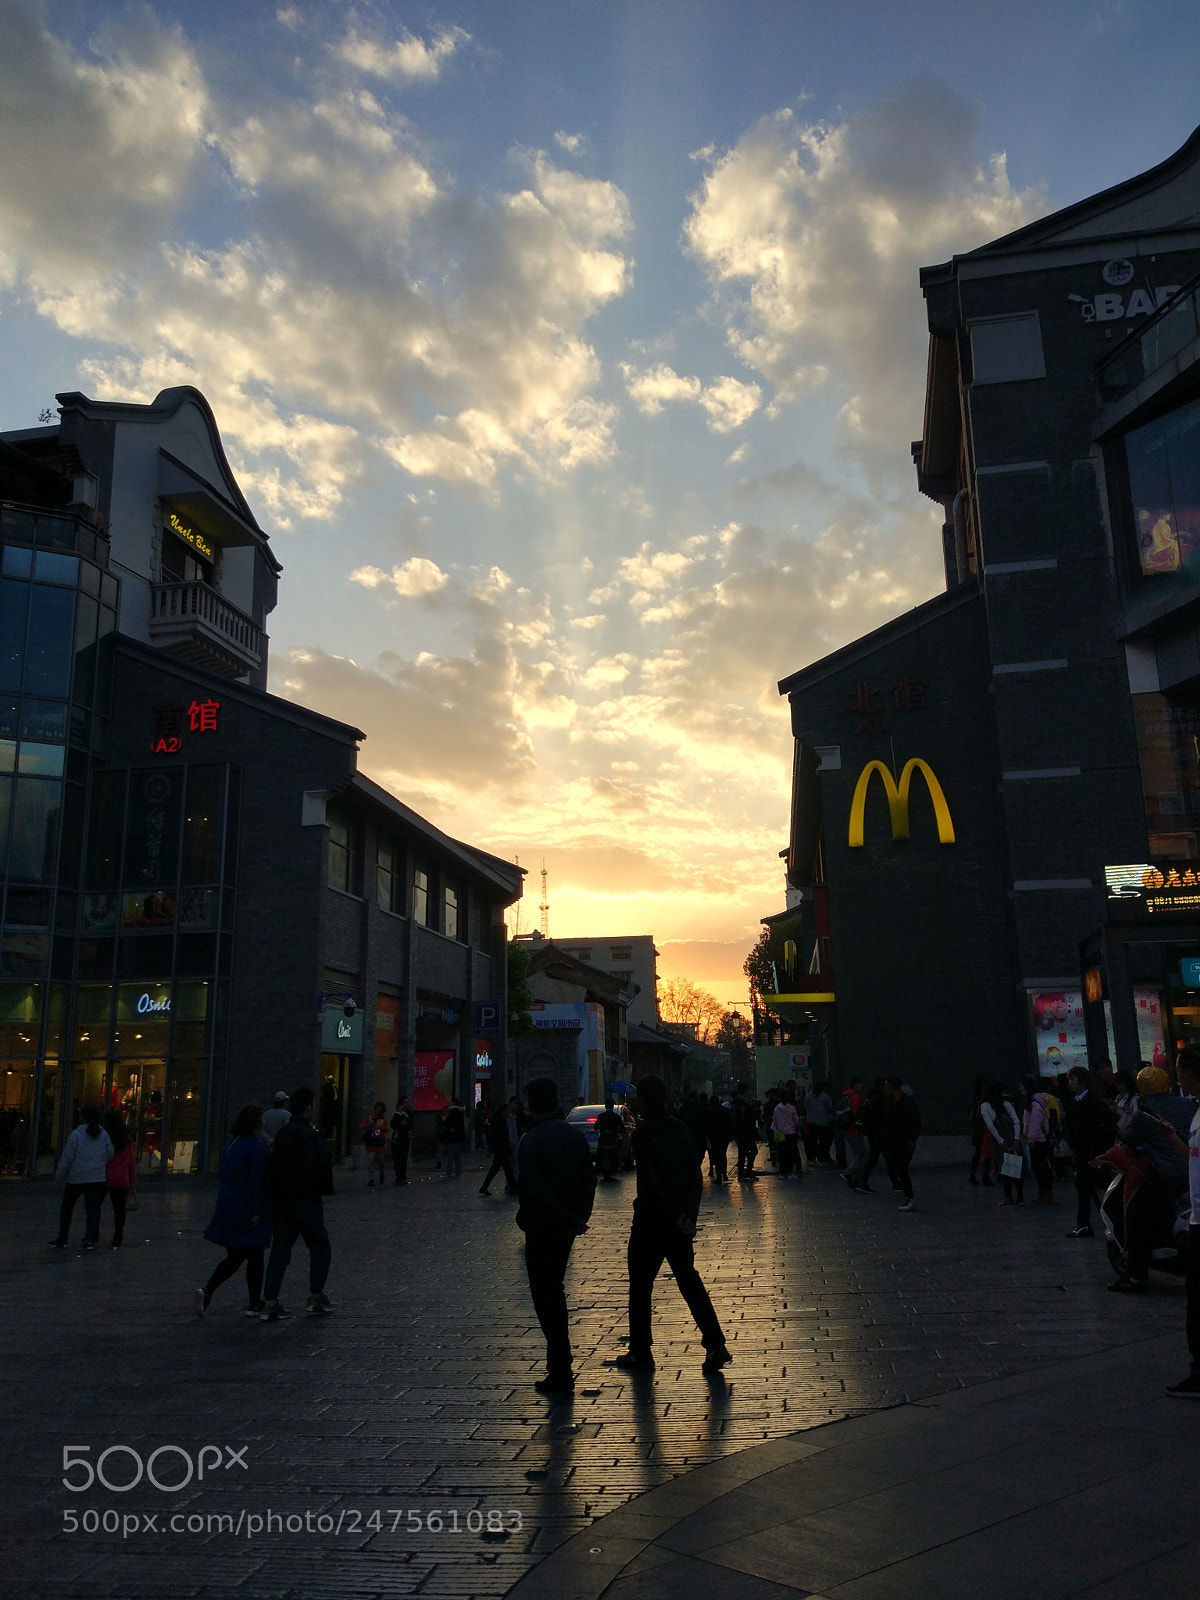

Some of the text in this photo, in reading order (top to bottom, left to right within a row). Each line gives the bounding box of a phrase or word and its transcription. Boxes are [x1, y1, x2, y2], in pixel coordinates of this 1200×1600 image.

[170, 514, 212, 556] Uncle Ben
[847, 673, 929, 714] 北馆
[150, 737, 183, 753] (A2)
[482, 1007, 496, 1027] P
